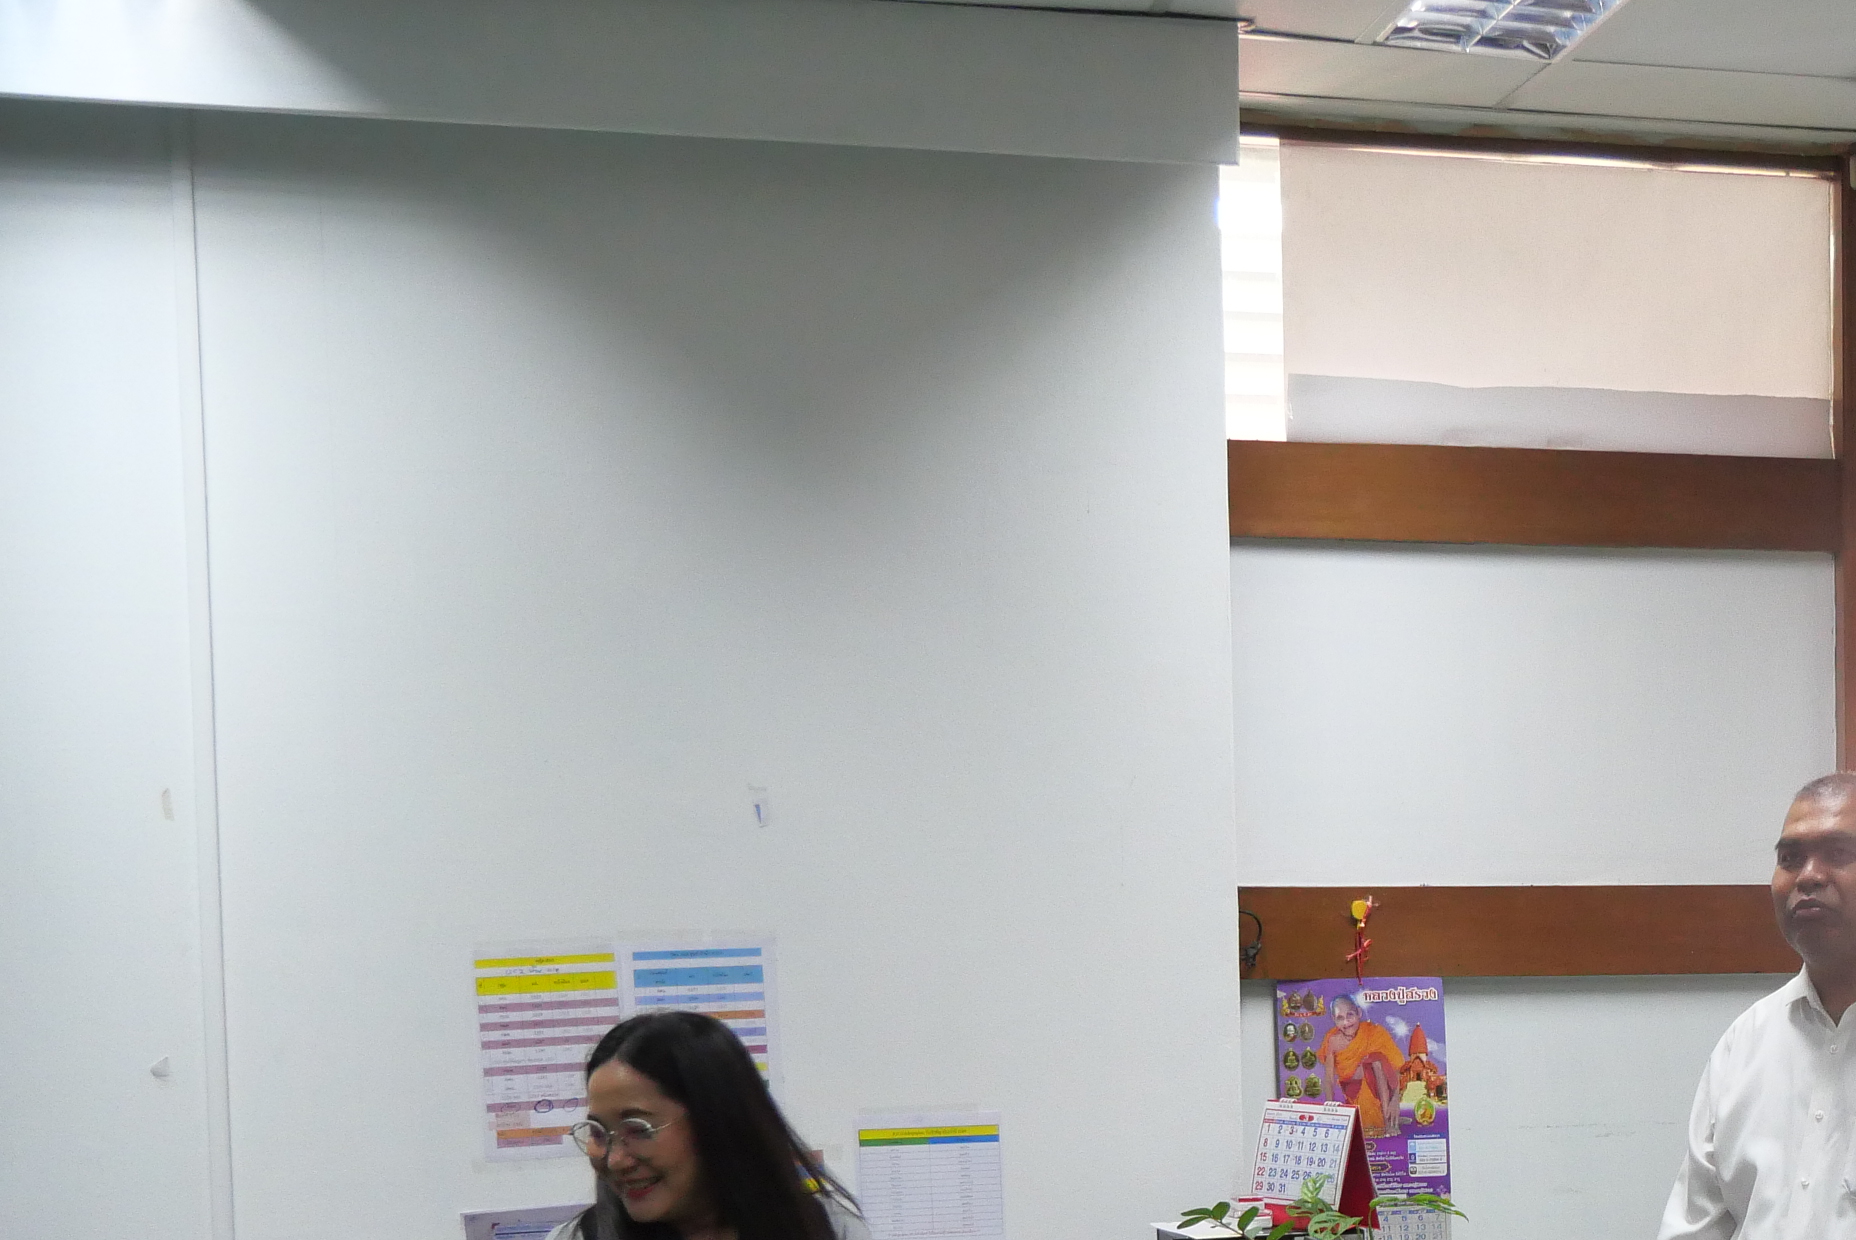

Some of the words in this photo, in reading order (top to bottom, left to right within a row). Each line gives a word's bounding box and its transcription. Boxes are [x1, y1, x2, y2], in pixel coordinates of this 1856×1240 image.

[1267, 1124, 1270, 1133] 1
[1278, 1125, 1283, 1134] 2
[1289, 1126, 1294, 1134] 3
[1301, 1128, 1305, 1136] 4
[1313, 1128, 1317, 1137] 5
[1325, 1129, 1330, 1138] 6
[1263, 1138, 1268, 1147] 8
[1275, 1139, 1279, 1148] 9
[1286, 1140, 1292, 1149] 10
[1297, 1141, 1304, 1150] 11
[1309, 1142, 1316, 1151] 12
[1321, 1143, 1328, 1152] 13
[1333, 1145, 1339, 1154] 14
[1260, 1152, 1267, 1161] 15
[1272, 1153, 1279, 1162] 16
[1283, 1155, 1290, 1163] 17
[1295, 1156, 1302, 1165] 18
[1306, 1157, 1313, 1166] 19
[1317, 1158, 1326, 1167] 20
[1329, 1159, 1337, 1168] 21
[1257, 1167, 1265, 1176] 22
[1268, 1168, 1276, 1177] 23
[1280, 1169, 1288, 1178] 24
[1291, 1170, 1300, 1180] 25
[1303, 1171, 1311, 1180] 26
[1255, 1181, 1263, 1190] 29
[1267, 1182, 1275, 1192] 30
[1279, 1183, 1286, 1193] 31
